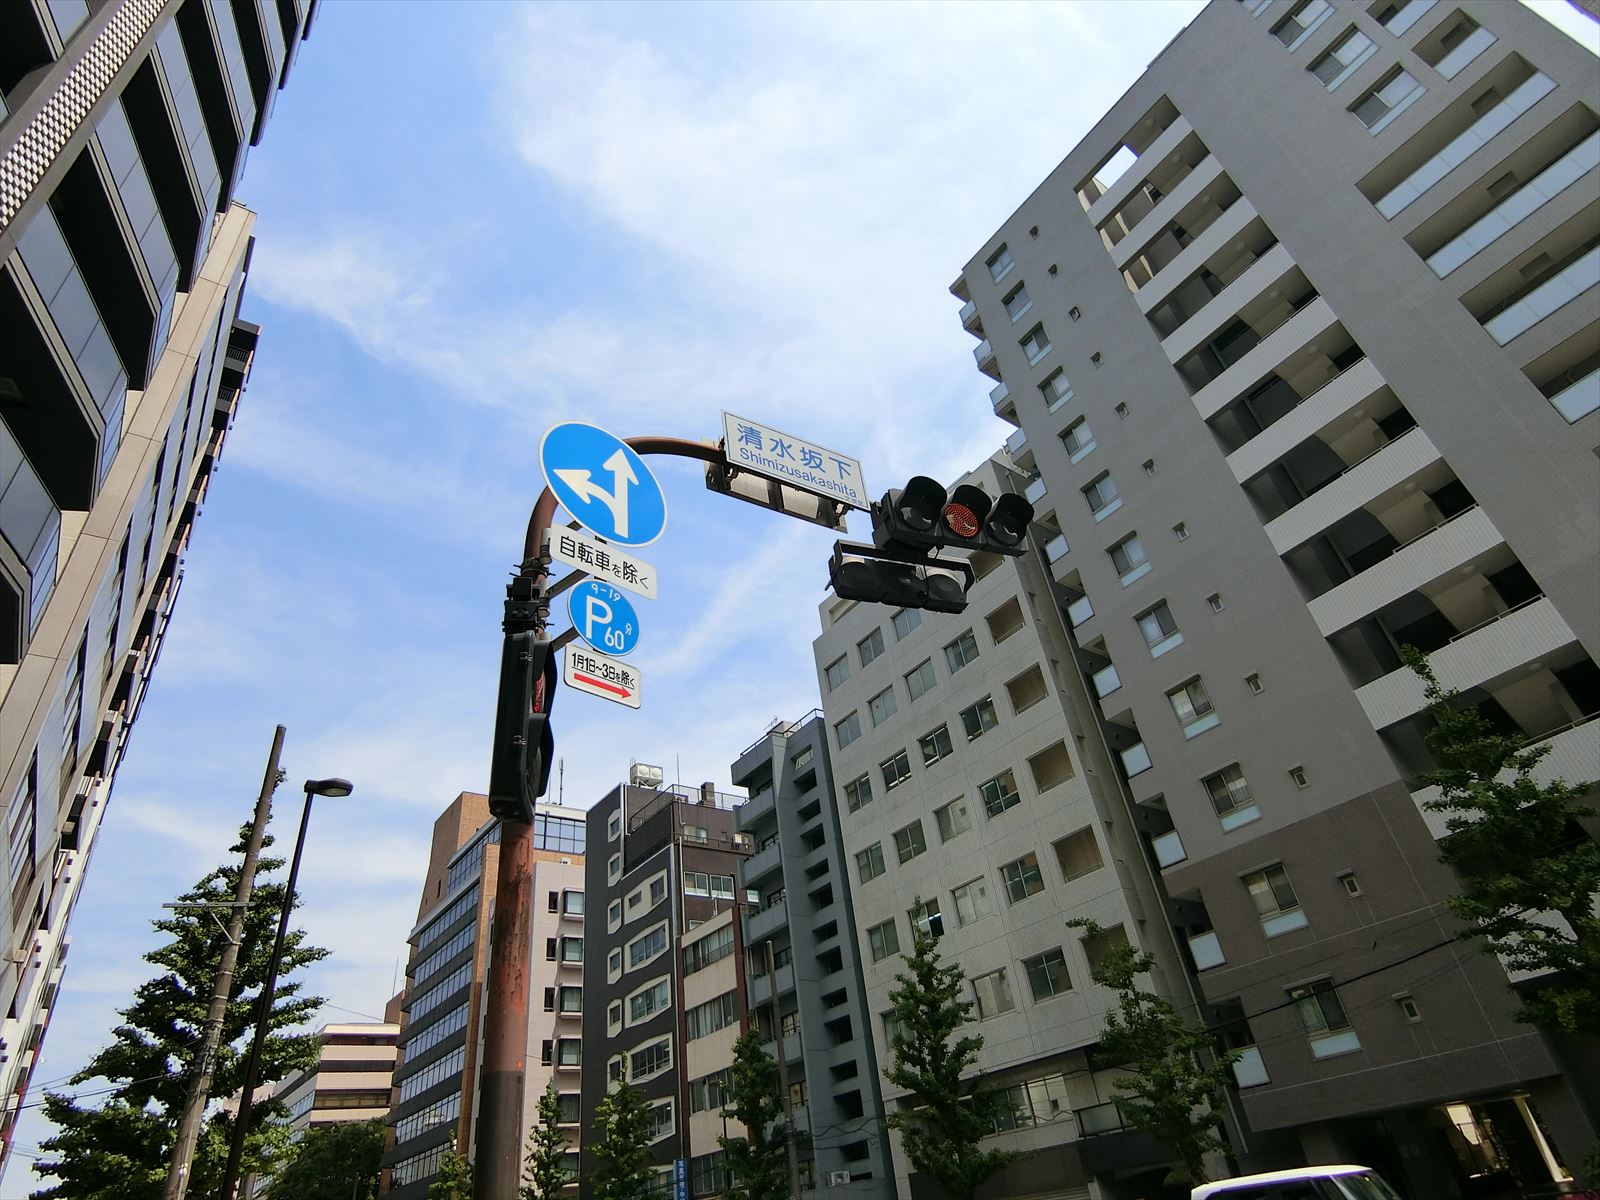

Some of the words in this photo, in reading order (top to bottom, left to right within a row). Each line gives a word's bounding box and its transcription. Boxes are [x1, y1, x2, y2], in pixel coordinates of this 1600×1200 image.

[737, 423, 851, 480] 清水坂下
[739, 447, 857, 498] Shimizusakashita
[560, 535, 648, 590] 自転車を除く
[585, 594, 613, 640] P
[591, 583, 621, 602] 9-19
